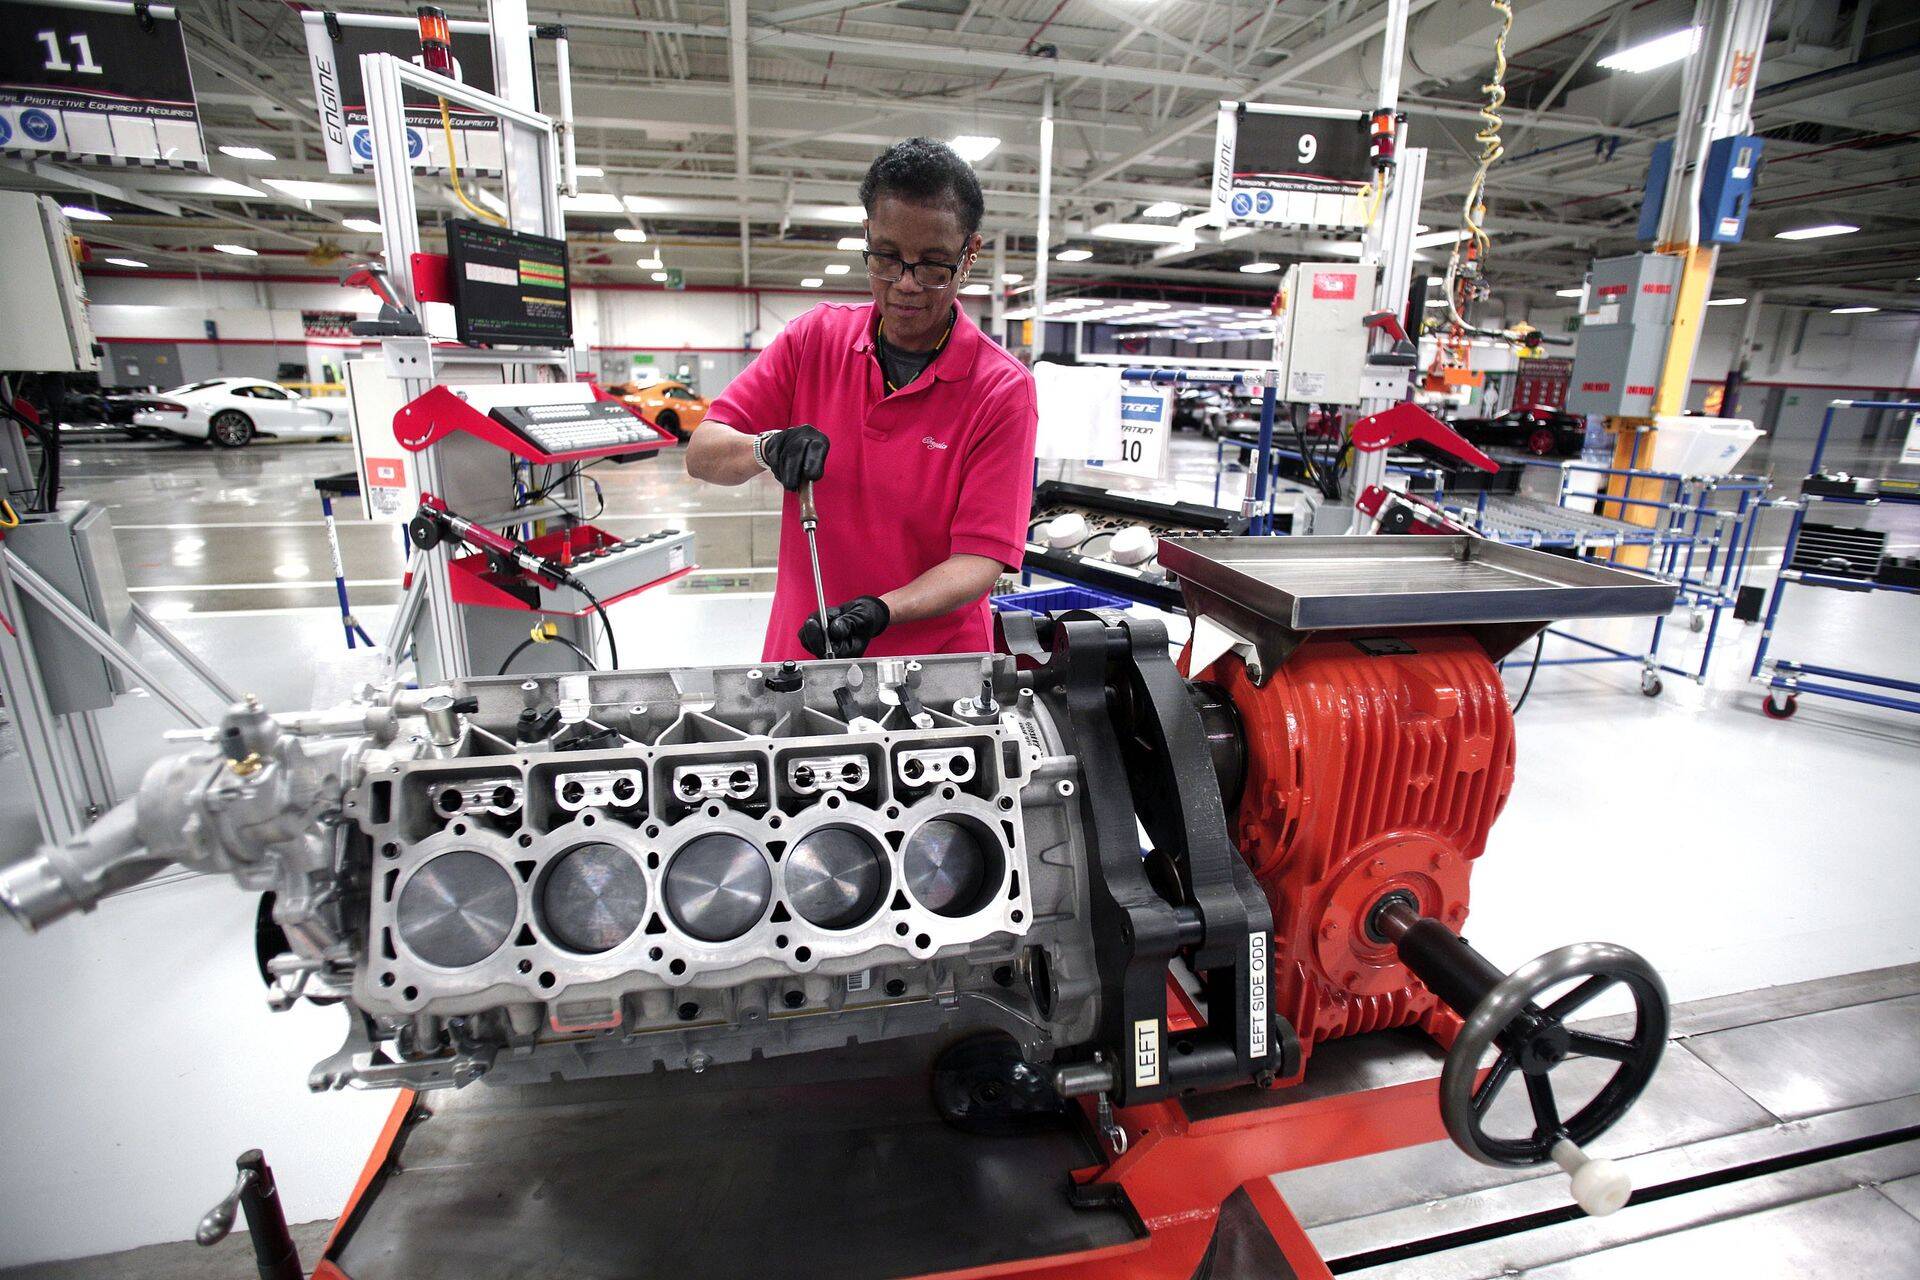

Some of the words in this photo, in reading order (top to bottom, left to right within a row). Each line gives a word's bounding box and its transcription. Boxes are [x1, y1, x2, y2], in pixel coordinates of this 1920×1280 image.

[38, 31, 103, 74] 11
[315, 55, 343, 145] ENGINE
[1297, 134, 1318, 164] 9
[1218, 137, 1233, 204] ENGINE
[1121, 425, 1154, 435] TATION
[1121, 439, 1142, 463] 10
[1252, 936, 1265, 971] ODD
[1252, 975, 1265, 1012] SIDE
[1138, 1027, 1156, 1079] LEFT
[1252, 1017, 1265, 1054] LEFT
